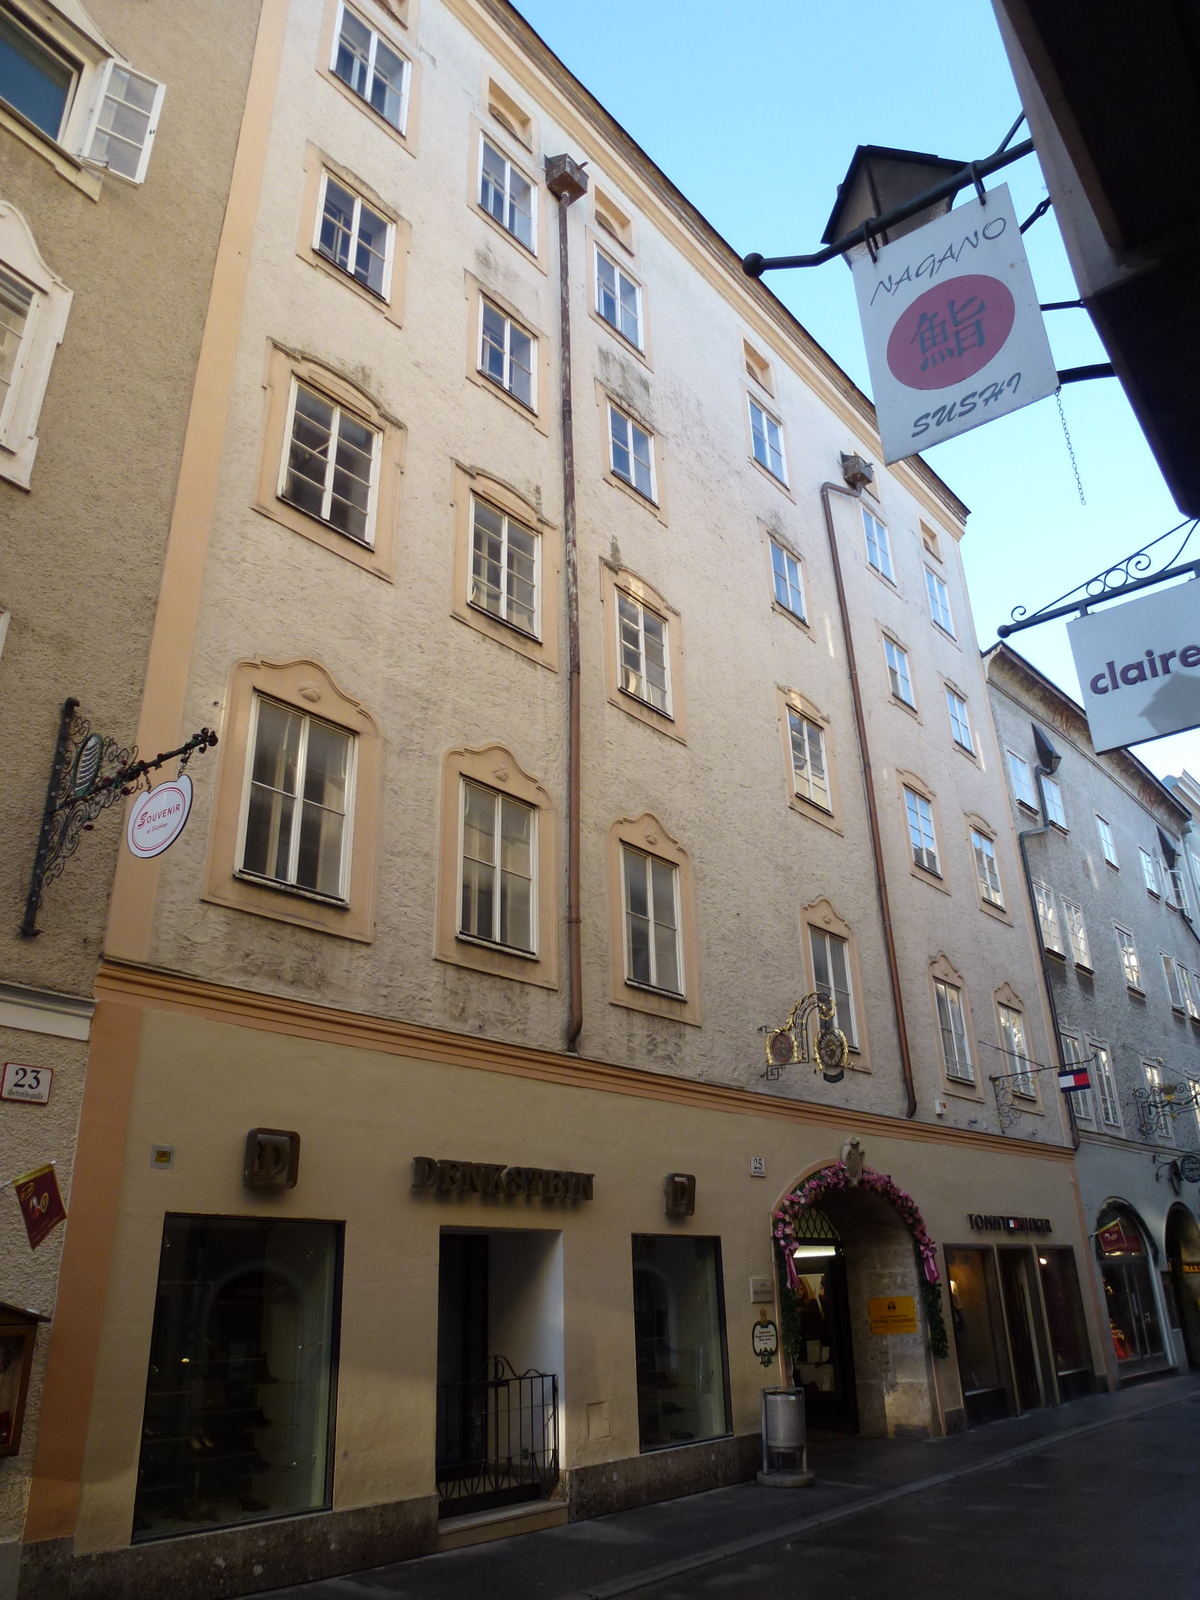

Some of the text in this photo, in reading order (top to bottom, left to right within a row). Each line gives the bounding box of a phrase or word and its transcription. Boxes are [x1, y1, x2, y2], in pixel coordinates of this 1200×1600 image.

[870, 217, 1007, 306] NAGANO
[909, 296, 987, 372] 鮨
[911, 372, 1022, 438] SUSHI
[1090, 644, 1200, 695] claire
[137, 803, 181, 829] SOUVENIR
[13, 1067, 41, 1089] 23
[412, 1156, 595, 1200] DENKSTEIN
[753, 1158, 763, 1170] 25
